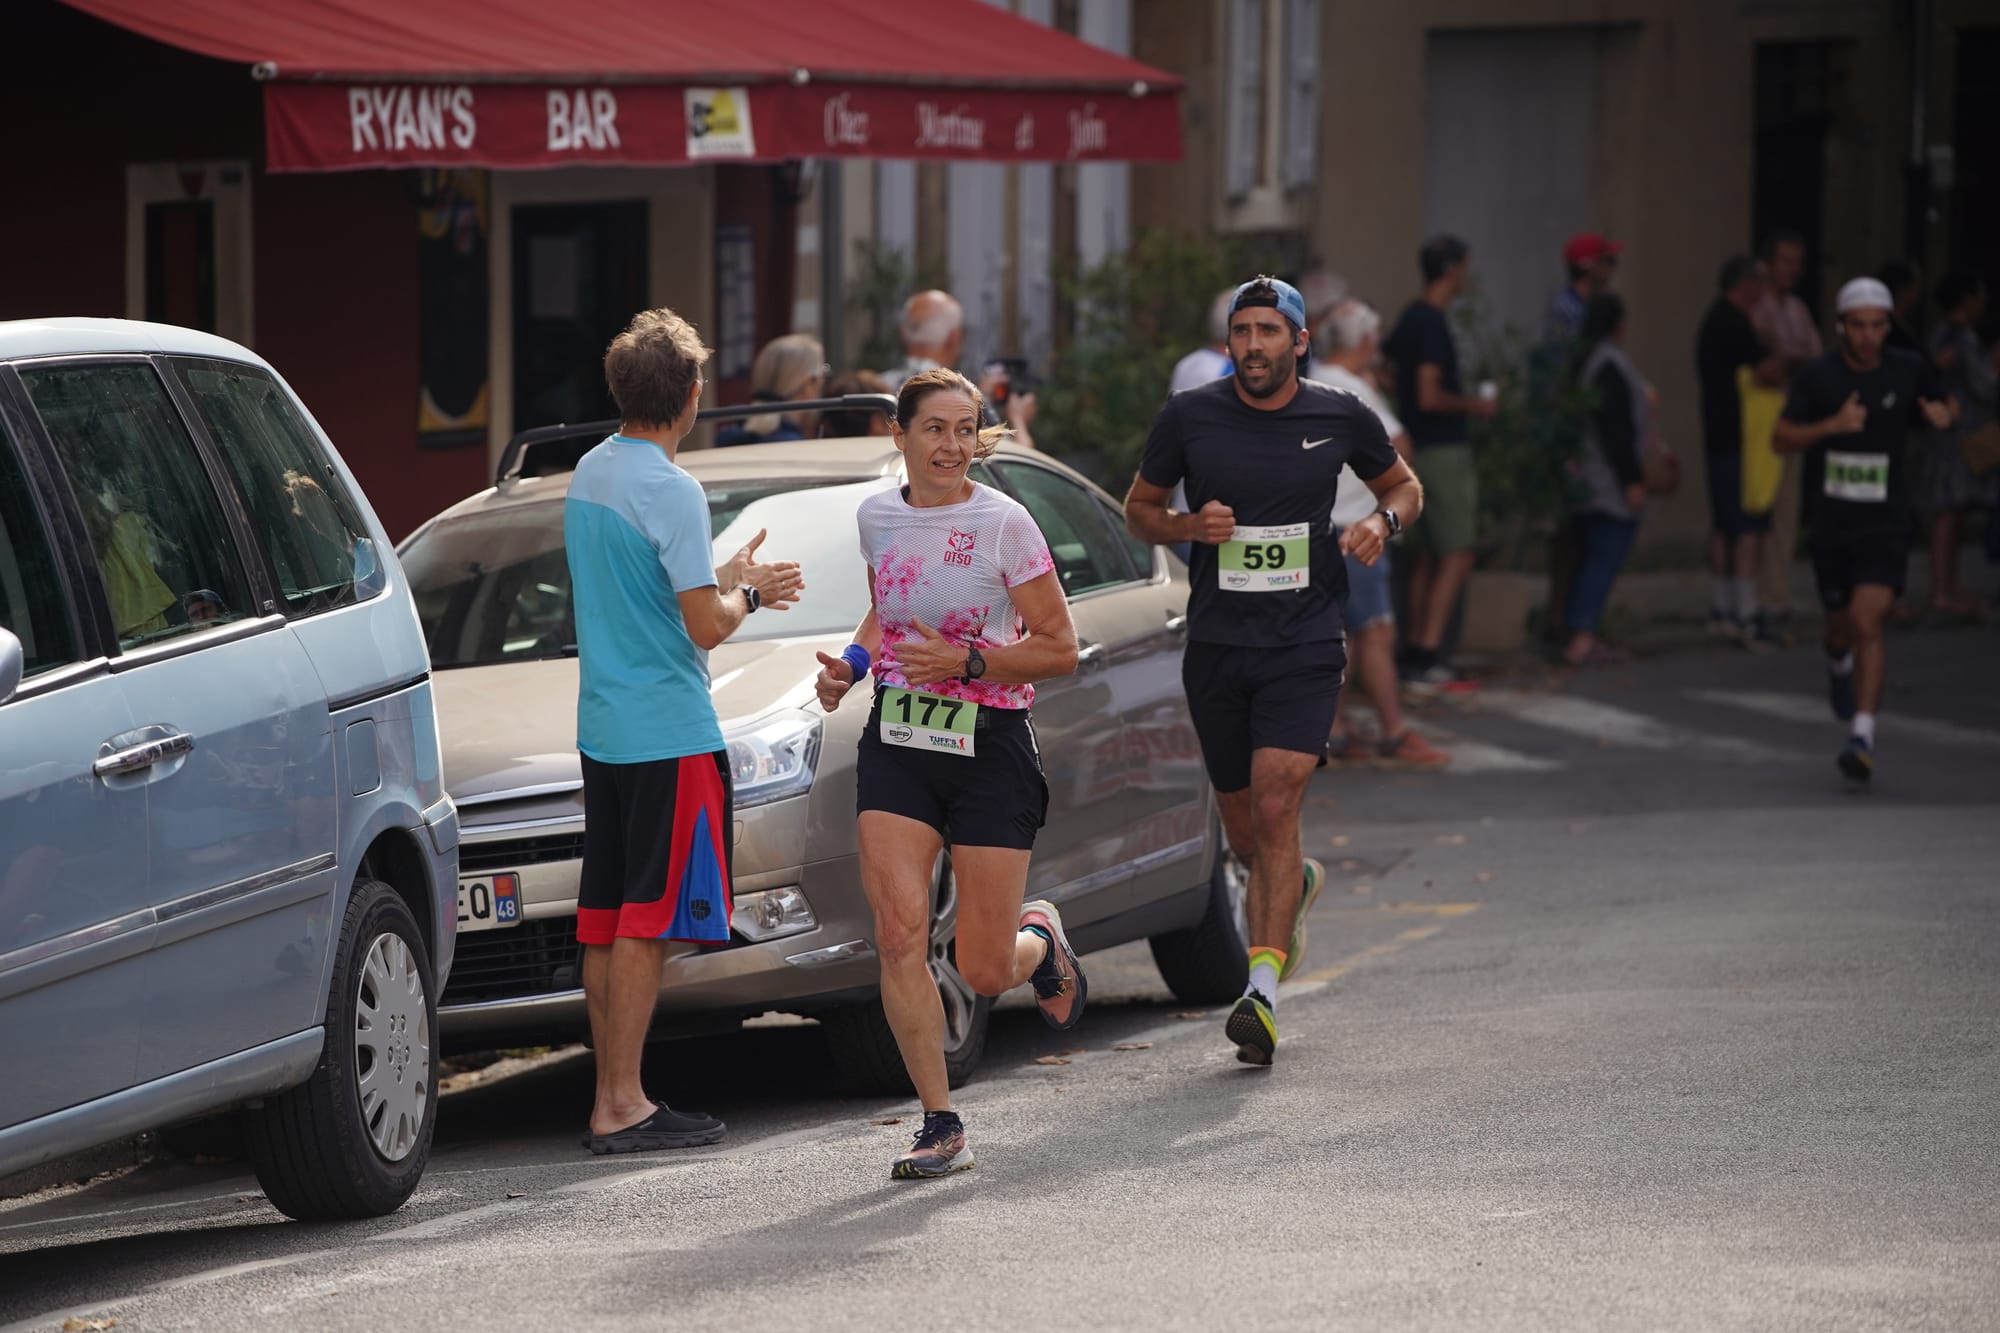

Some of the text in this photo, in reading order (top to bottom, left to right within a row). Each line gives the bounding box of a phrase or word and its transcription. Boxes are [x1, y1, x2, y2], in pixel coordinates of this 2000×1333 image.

[349, 86, 620, 152] RYAN'S BAR
[823, 92, 869, 147] Chez
[1015, 112, 1034, 150] et
[943, 550, 972, 566] OTSO
[1243, 544, 1286, 569] 59
[896, 693, 963, 730] 177
[929, 735, 957, 745] TUFF'S
[498, 900, 515, 918] 48
